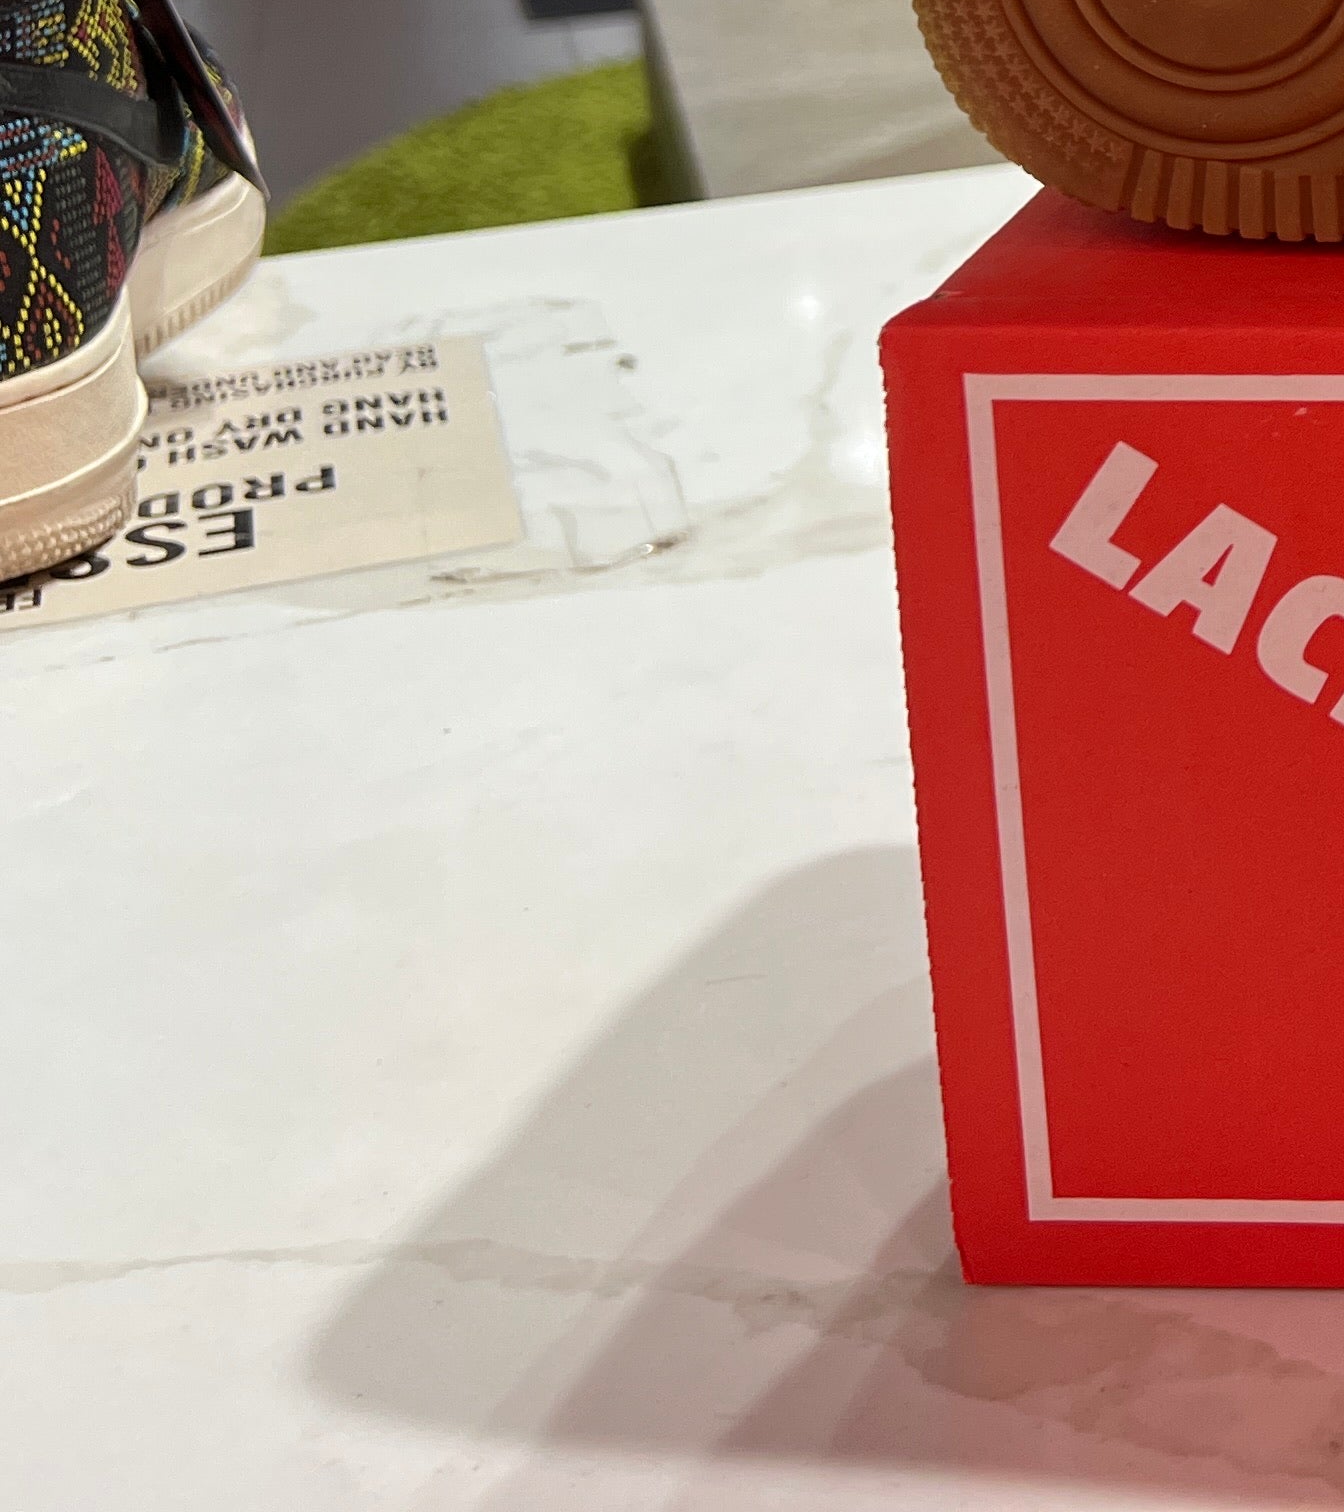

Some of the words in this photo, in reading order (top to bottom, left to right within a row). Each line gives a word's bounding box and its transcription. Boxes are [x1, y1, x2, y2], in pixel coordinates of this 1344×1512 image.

[138, 428, 194, 450] ON
[322, 409, 448, 437] HAND
[168, 427, 303, 467] WASH
[137, 465, 336, 518] PROD
